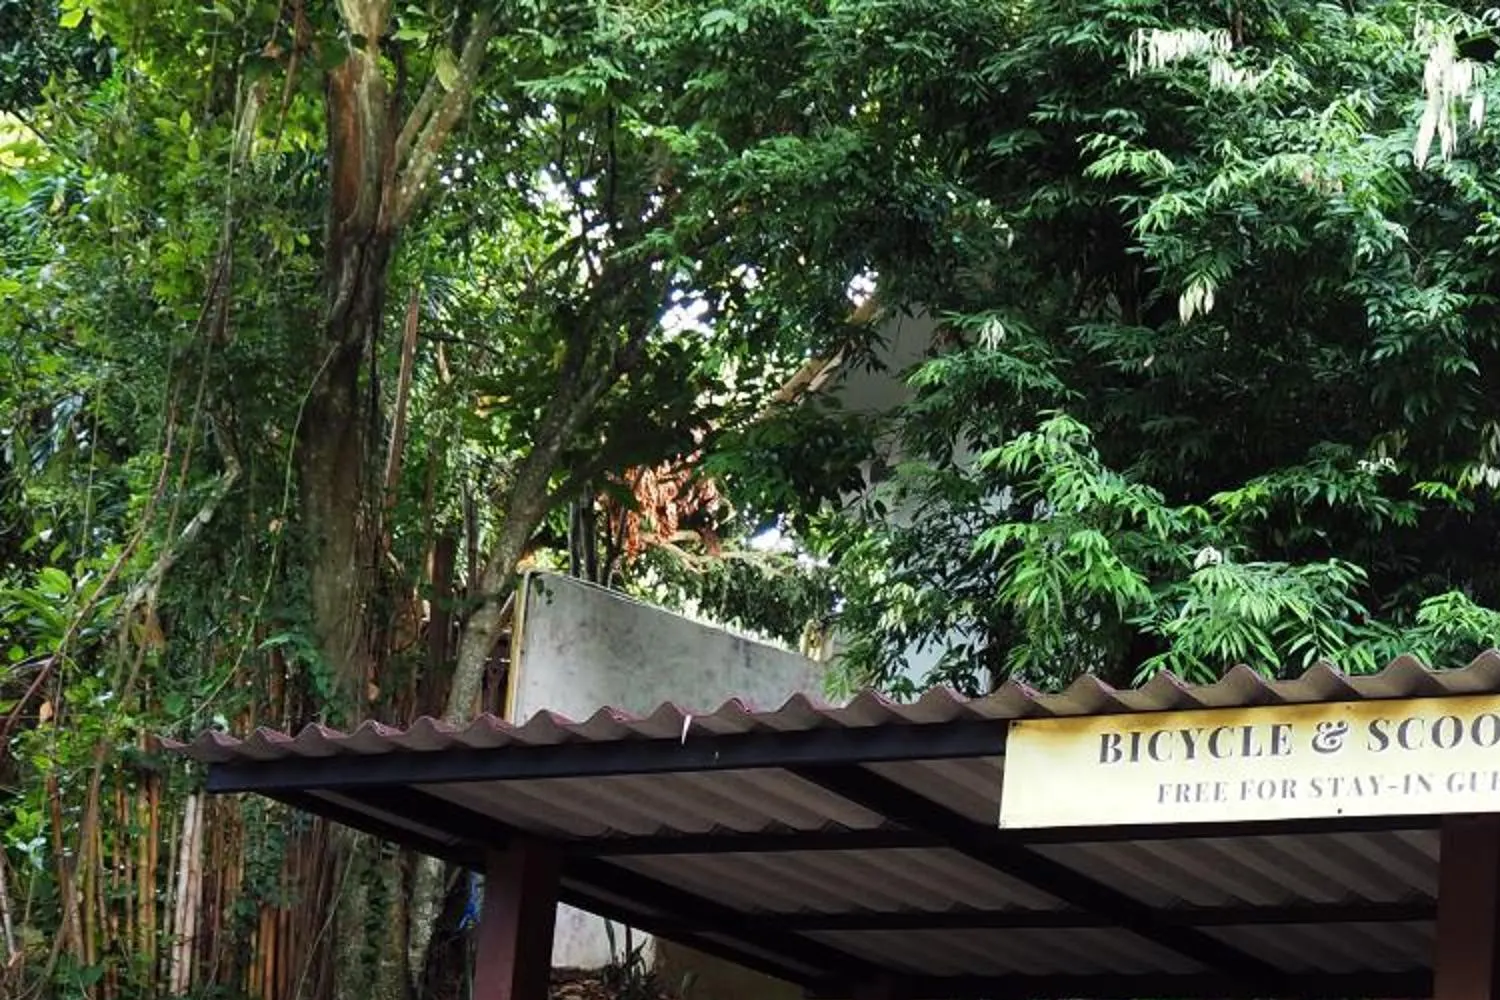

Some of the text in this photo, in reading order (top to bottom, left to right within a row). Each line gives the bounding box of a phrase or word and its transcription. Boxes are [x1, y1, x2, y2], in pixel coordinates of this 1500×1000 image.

[1099, 723, 1293, 764] BICYCLE
[1311, 720, 1349, 754] &
[1157, 780, 1229, 805] FREE
[1240, 776, 1298, 802] FOR
[1309, 772, 1433, 799] STAY-IN
